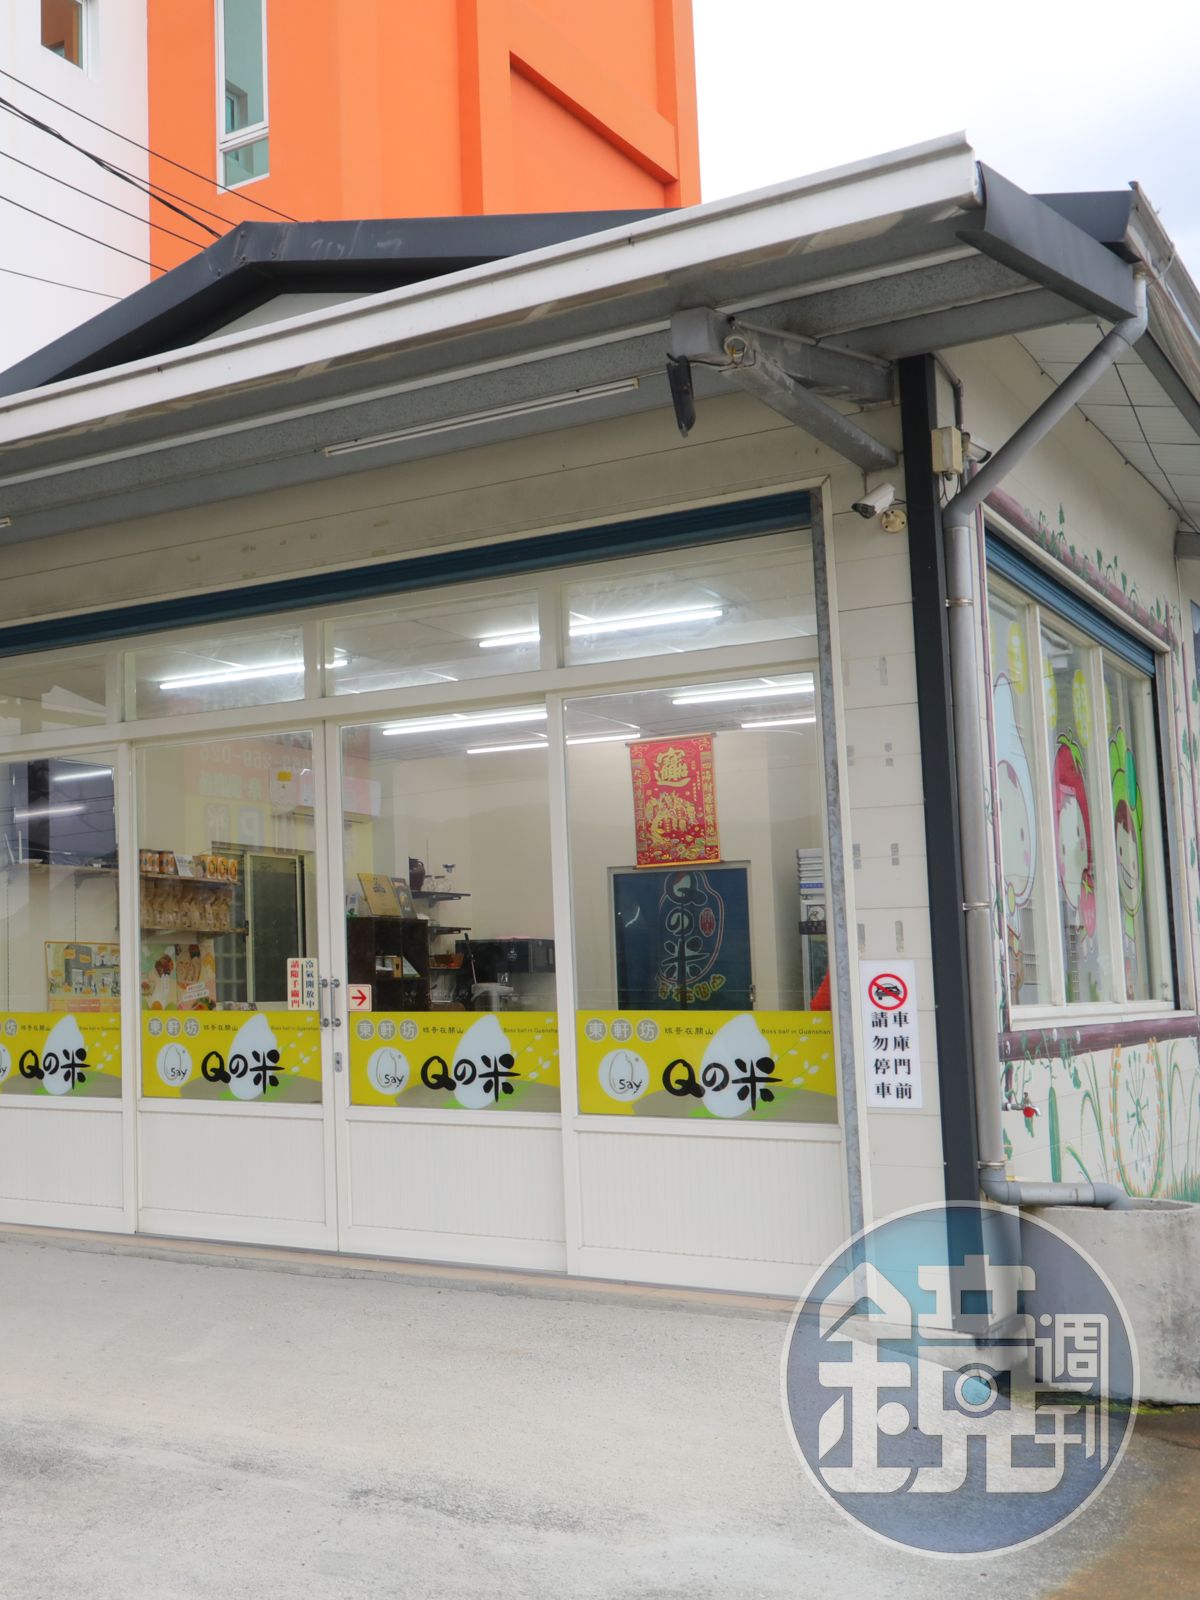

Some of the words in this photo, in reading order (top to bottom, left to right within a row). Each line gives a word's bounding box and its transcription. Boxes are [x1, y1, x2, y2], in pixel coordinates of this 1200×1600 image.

[305, 960, 315, 1009] 冷氣開放中
[149, 1018, 198, 1036] 東軒坊
[356, 1020, 417, 1040] 東軒坊
[586, 1020, 658, 1041] 東軒坊
[19, 1048, 91, 1090] Qの米
[170, 1067, 187, 1080] Say
[201, 1049, 285, 1095] Qの米
[871, 1011, 892, 1099] 請勿停車
[892, 1011, 912, 1099] 車庫門前
[384, 1074, 404, 1087] Say
[421, 1053, 521, 1103] Qの米
[618, 1078, 642, 1095] Say
[662, 1056, 783, 1111] Qの米
